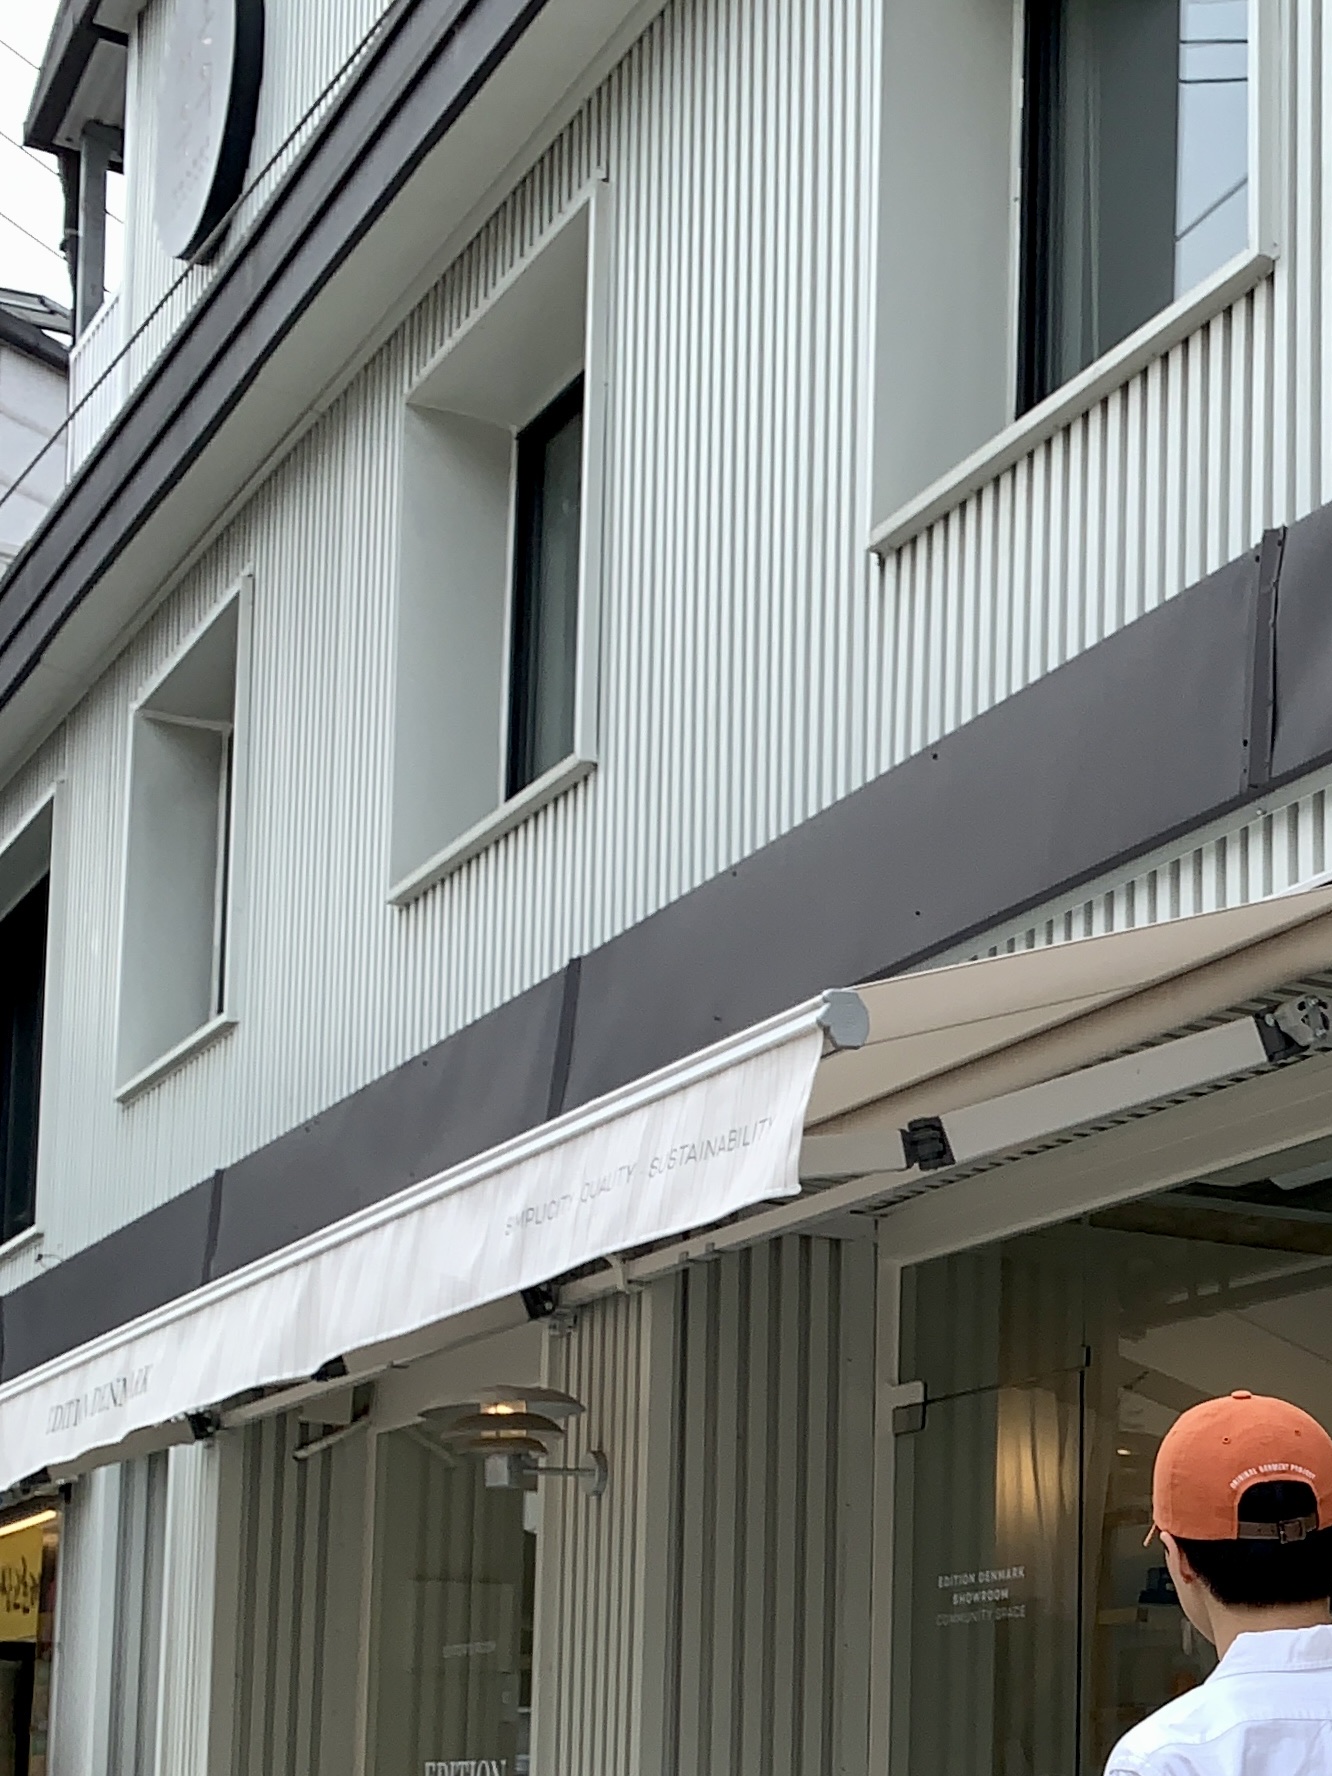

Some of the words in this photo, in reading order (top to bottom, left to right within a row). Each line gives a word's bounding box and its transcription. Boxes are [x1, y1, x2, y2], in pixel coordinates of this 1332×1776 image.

[580, 1163, 637, 1203] QUALITY
[649, 1116, 775, 1178] SUSTAINABILITY
[978, 1565, 1025, 1584] DENMARK
[952, 1588, 1009, 1605] SHOWROOM
